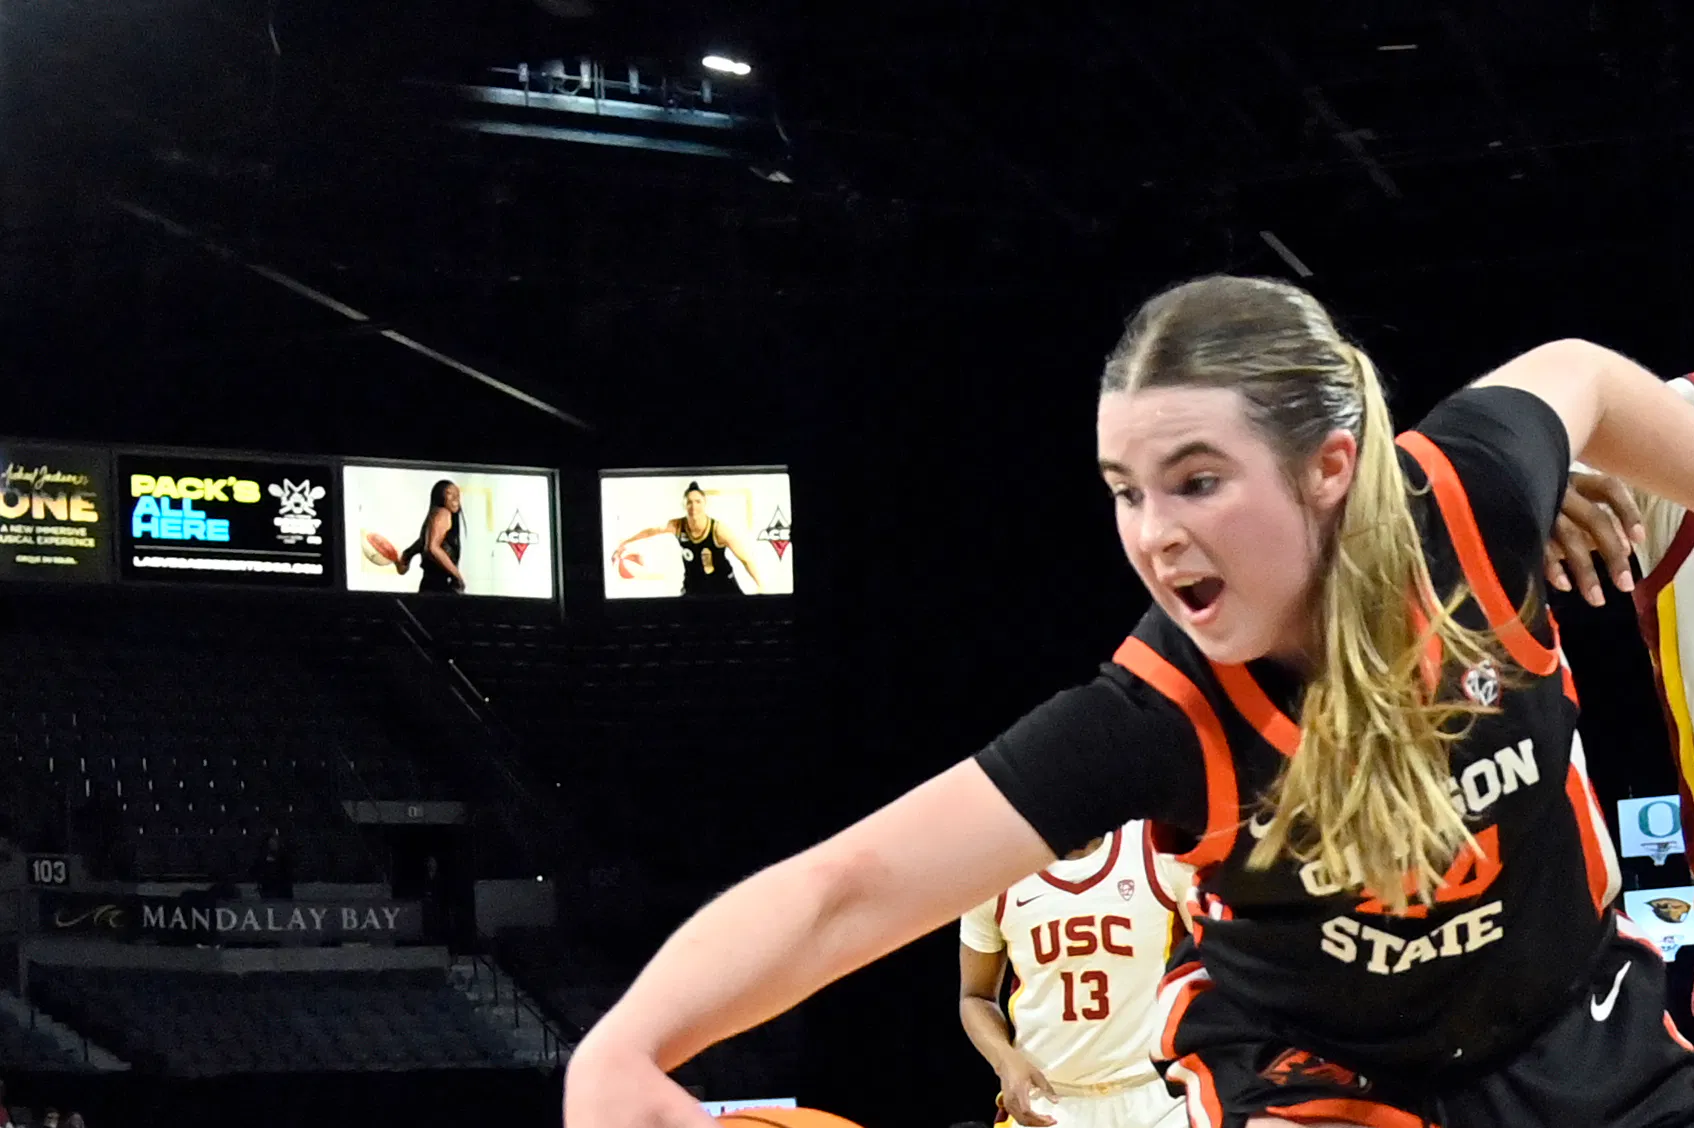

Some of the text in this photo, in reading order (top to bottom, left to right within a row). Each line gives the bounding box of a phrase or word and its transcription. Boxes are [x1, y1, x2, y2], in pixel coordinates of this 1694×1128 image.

[130, 474, 261, 503] PACK'S
[0, 490, 99, 522] ONE
[133, 495, 206, 519] ALL
[132, 514, 230, 542] HERE
[32, 859, 66, 884] 103
[142, 904, 401, 932] MANDALAY BAY
[1030, 915, 1134, 966] USC
[1321, 900, 1504, 976] STATE
[1060, 970, 1110, 1022] 13
